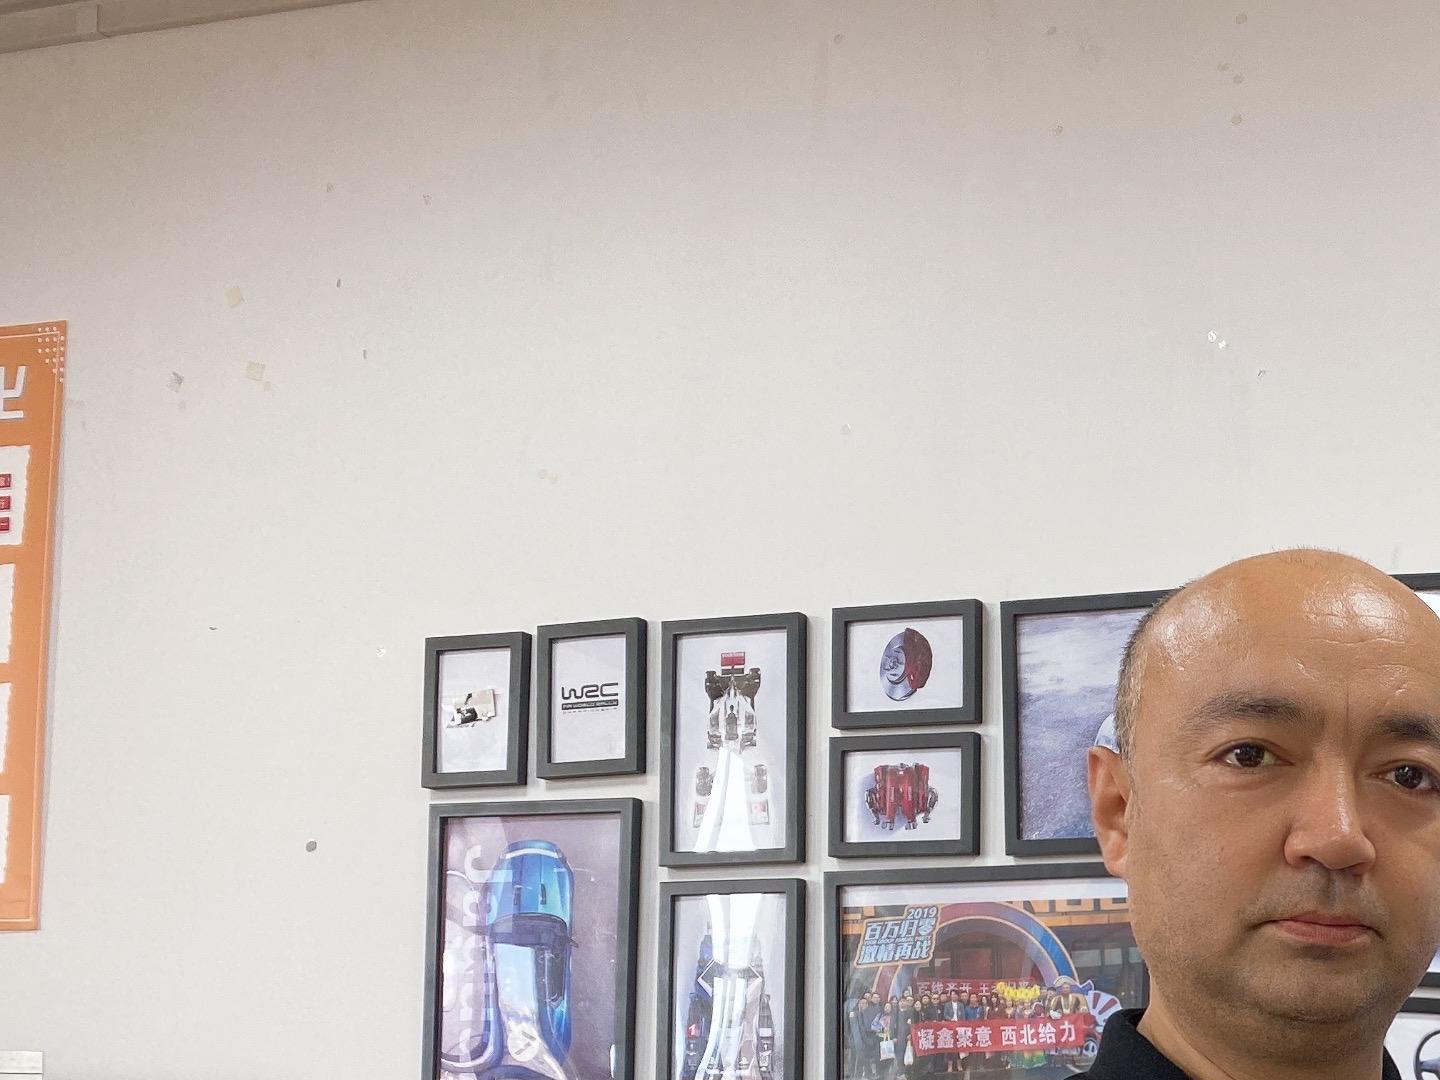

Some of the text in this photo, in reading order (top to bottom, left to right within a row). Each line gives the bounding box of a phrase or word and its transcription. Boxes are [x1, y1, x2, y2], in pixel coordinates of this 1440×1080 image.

[562, 682, 619, 700] WRC
[907, 906, 937, 920] 2019
[917, 1021, 1077, 1050] 凝鑫聚意 西北给力
